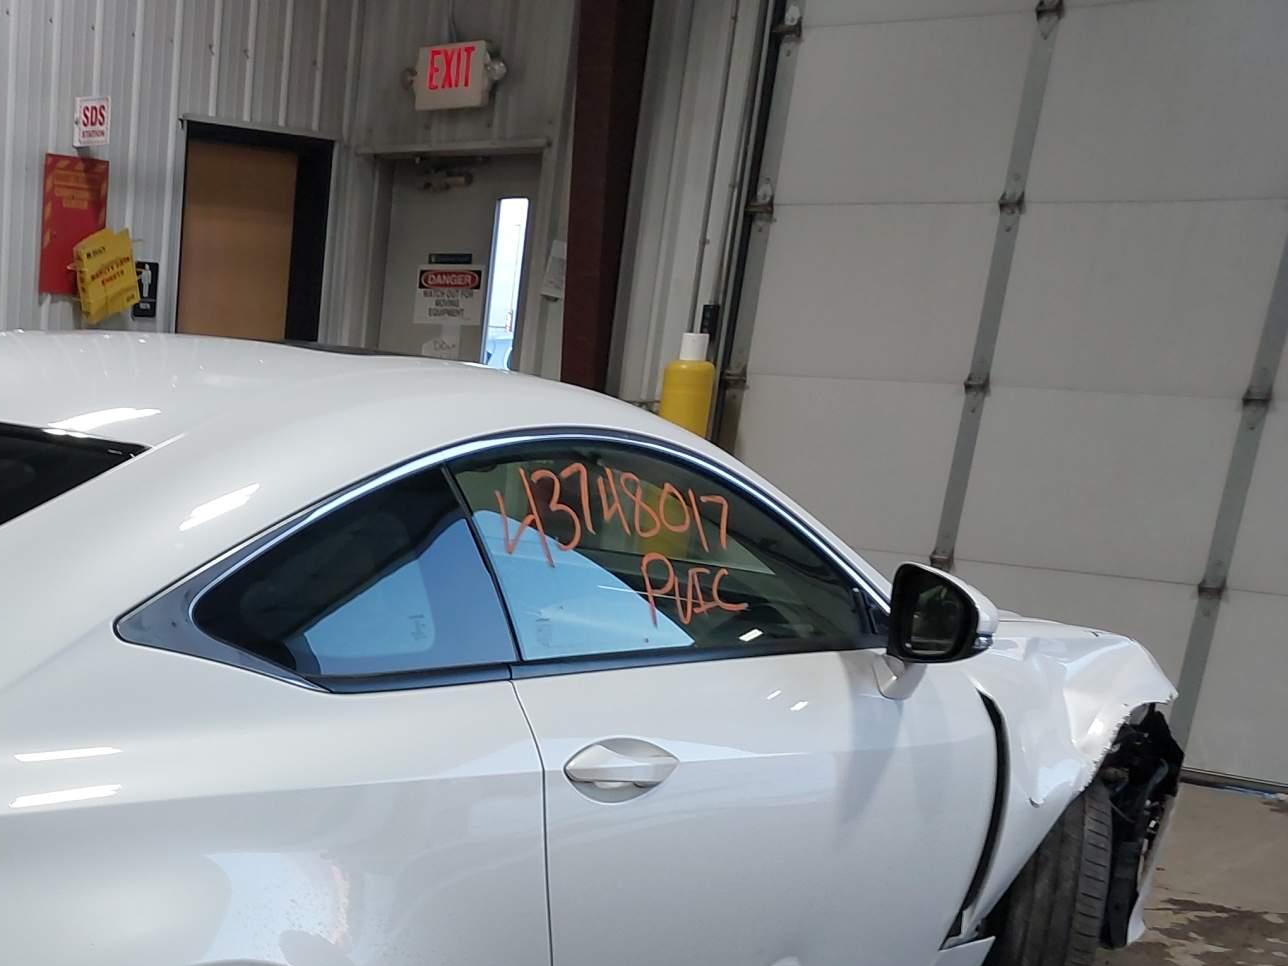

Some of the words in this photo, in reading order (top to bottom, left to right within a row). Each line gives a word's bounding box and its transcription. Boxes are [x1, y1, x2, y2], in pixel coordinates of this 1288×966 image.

[428, 46, 476, 90] EXIT
[82, 104, 106, 128] SDS
[427, 273, 472, 285] DANGER
[494, 463, 728, 568] 43748017
